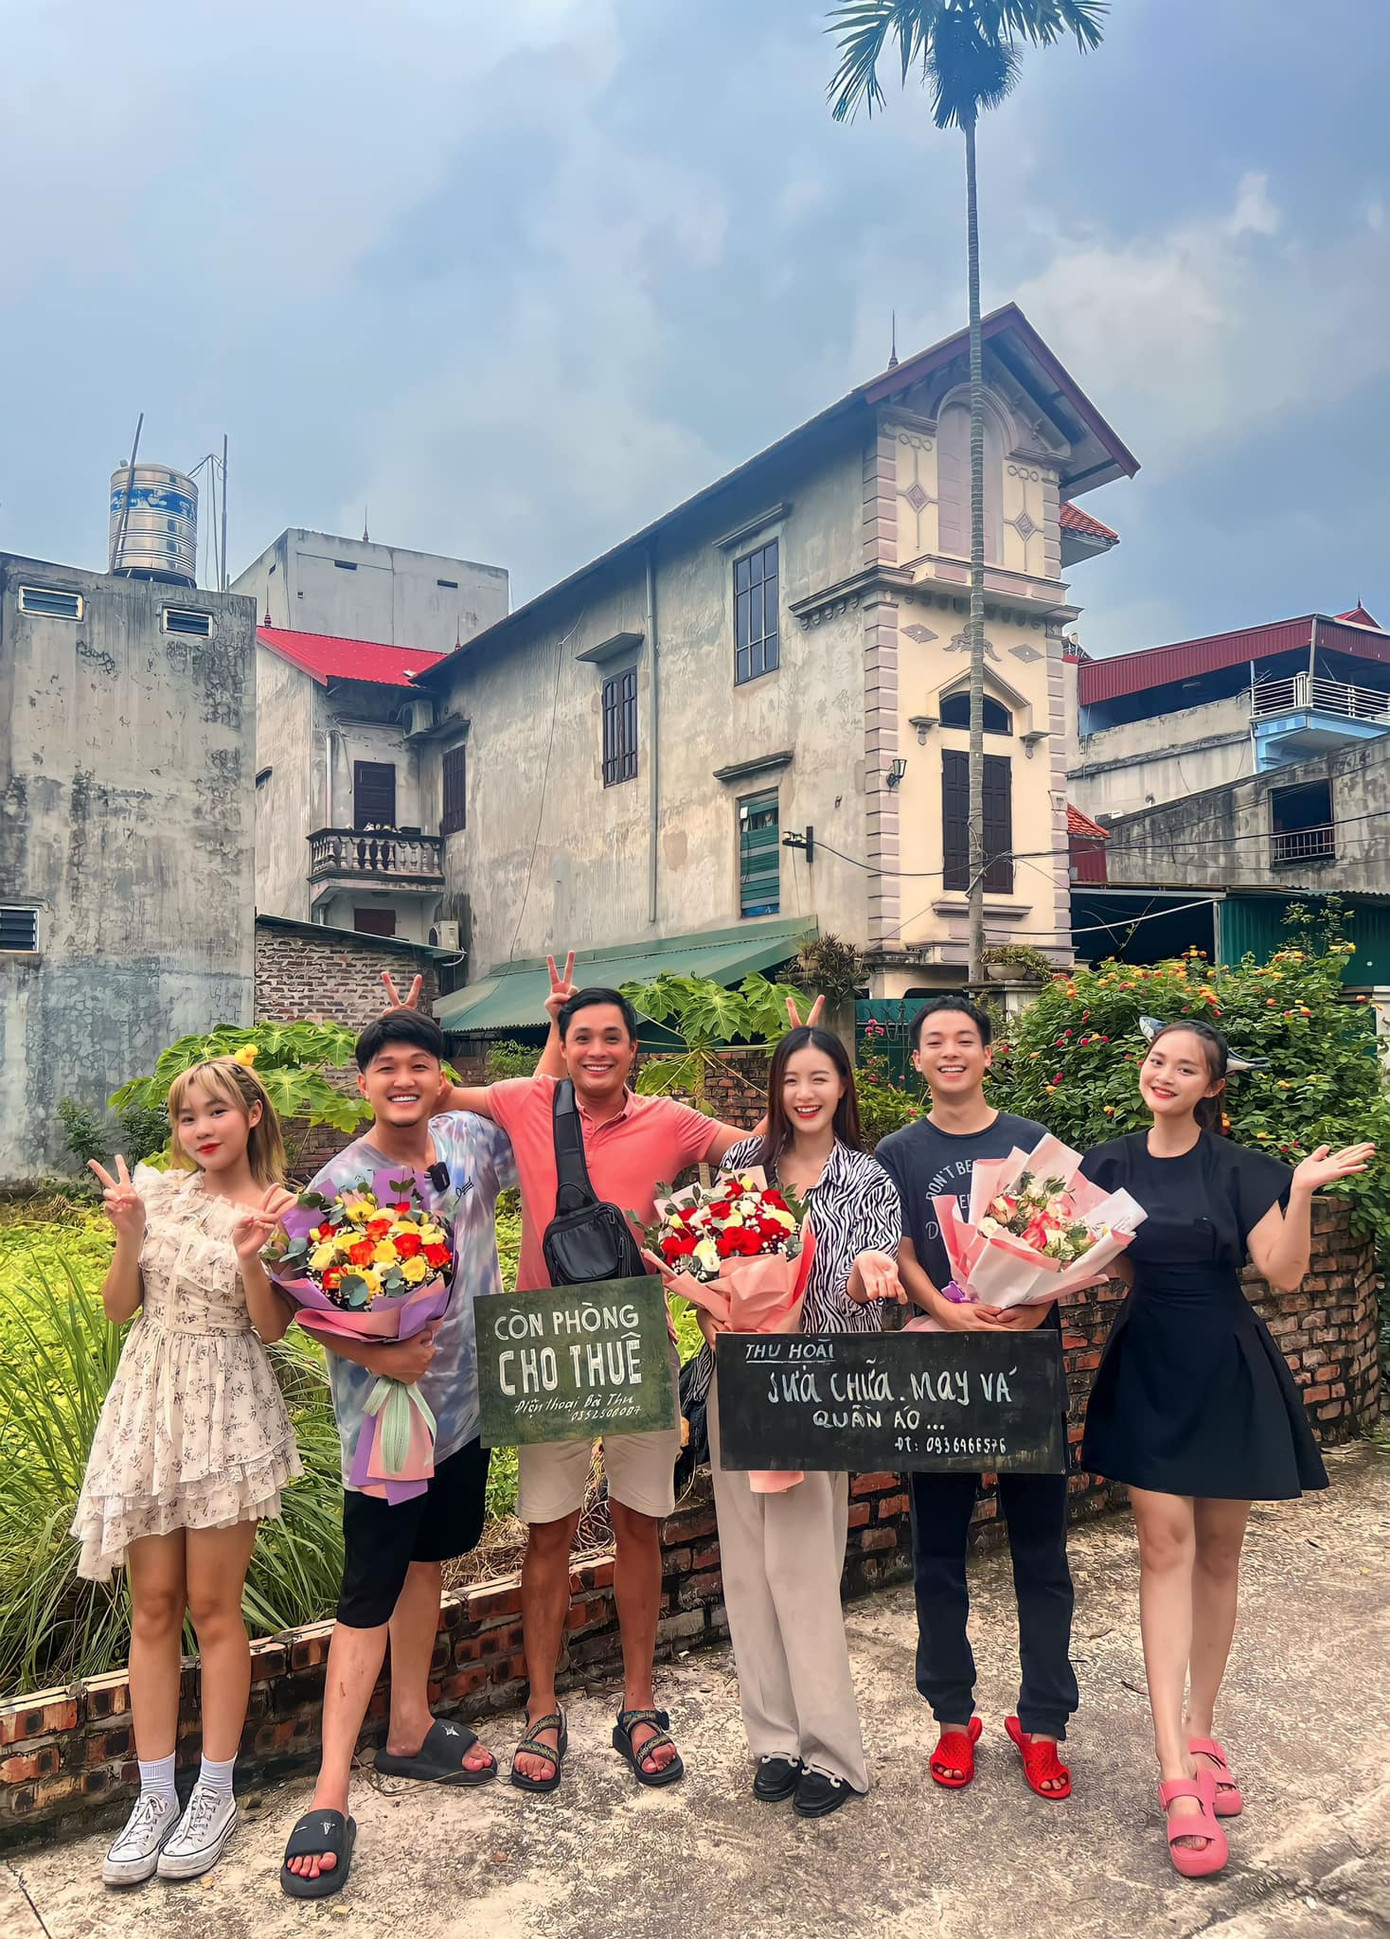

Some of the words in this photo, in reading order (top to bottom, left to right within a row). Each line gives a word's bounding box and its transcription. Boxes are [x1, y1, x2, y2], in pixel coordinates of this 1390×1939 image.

[926, 1165, 955, 1200] DON'T
[956, 1159, 974, 1175] BE
[494, 1308, 544, 1341] CÒN
[553, 1301, 639, 1335] PHÒNG
[499, 1346, 559, 1396] CHO
[569, 1331, 643, 1388] THUÊ
[745, 1343, 782, 1359] THU
[979, 1365, 1018, 1403] VÁ
